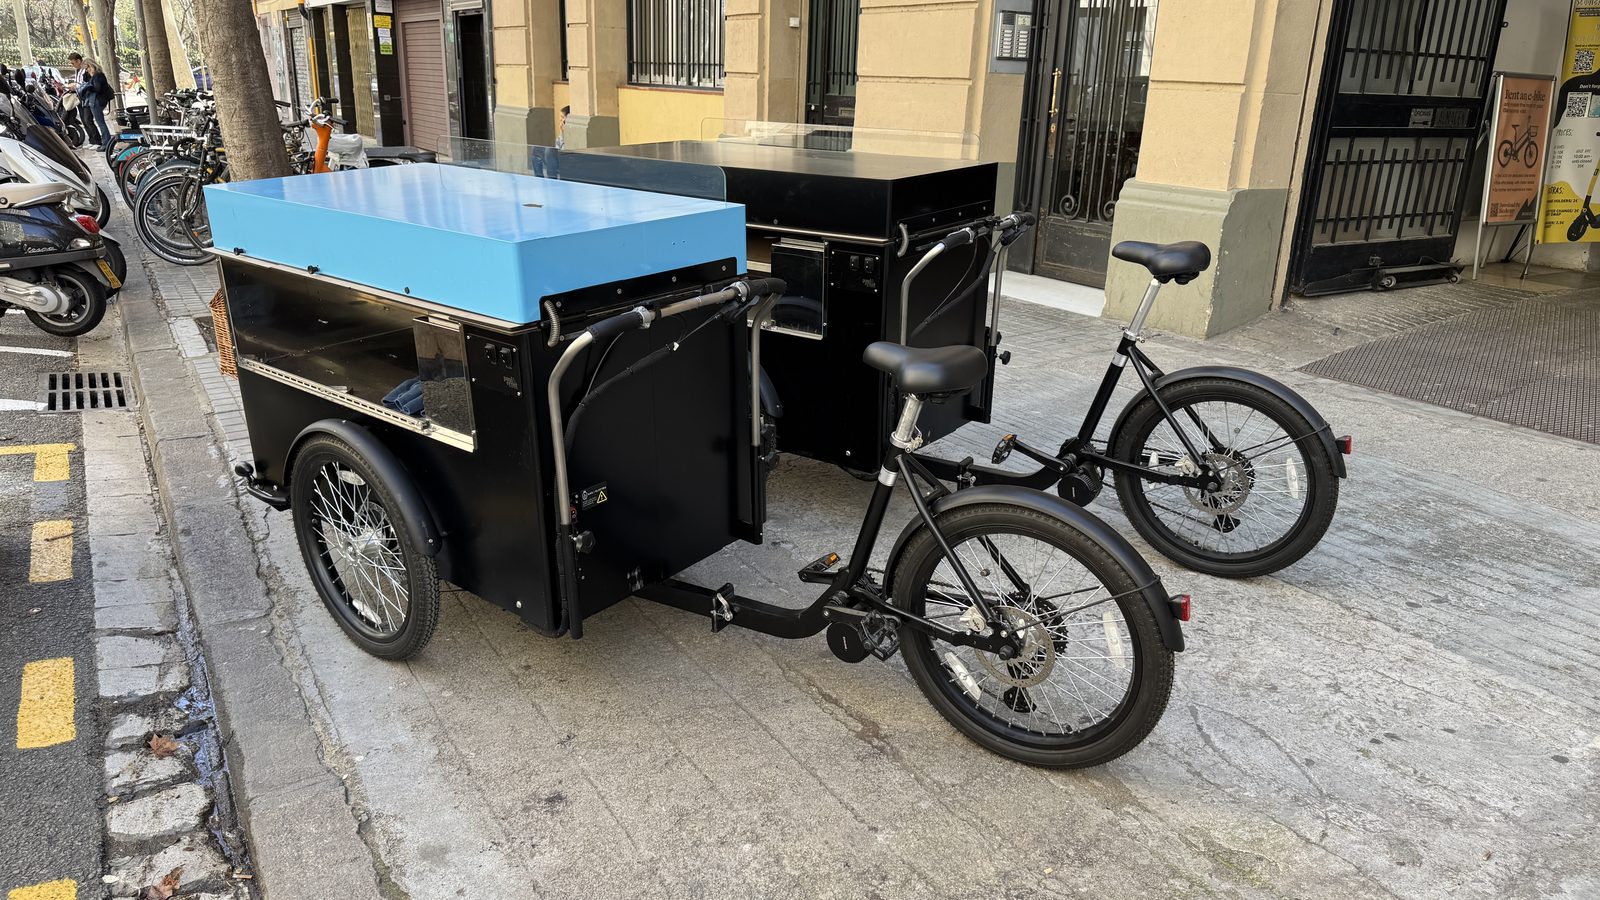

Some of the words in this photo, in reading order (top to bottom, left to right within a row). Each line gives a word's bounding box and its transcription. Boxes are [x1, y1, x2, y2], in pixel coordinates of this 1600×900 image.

[1504, 89, 1519, 100] Rent
[1520, 91, 1527, 101] an
[1528, 89, 1546, 102] e-bike
